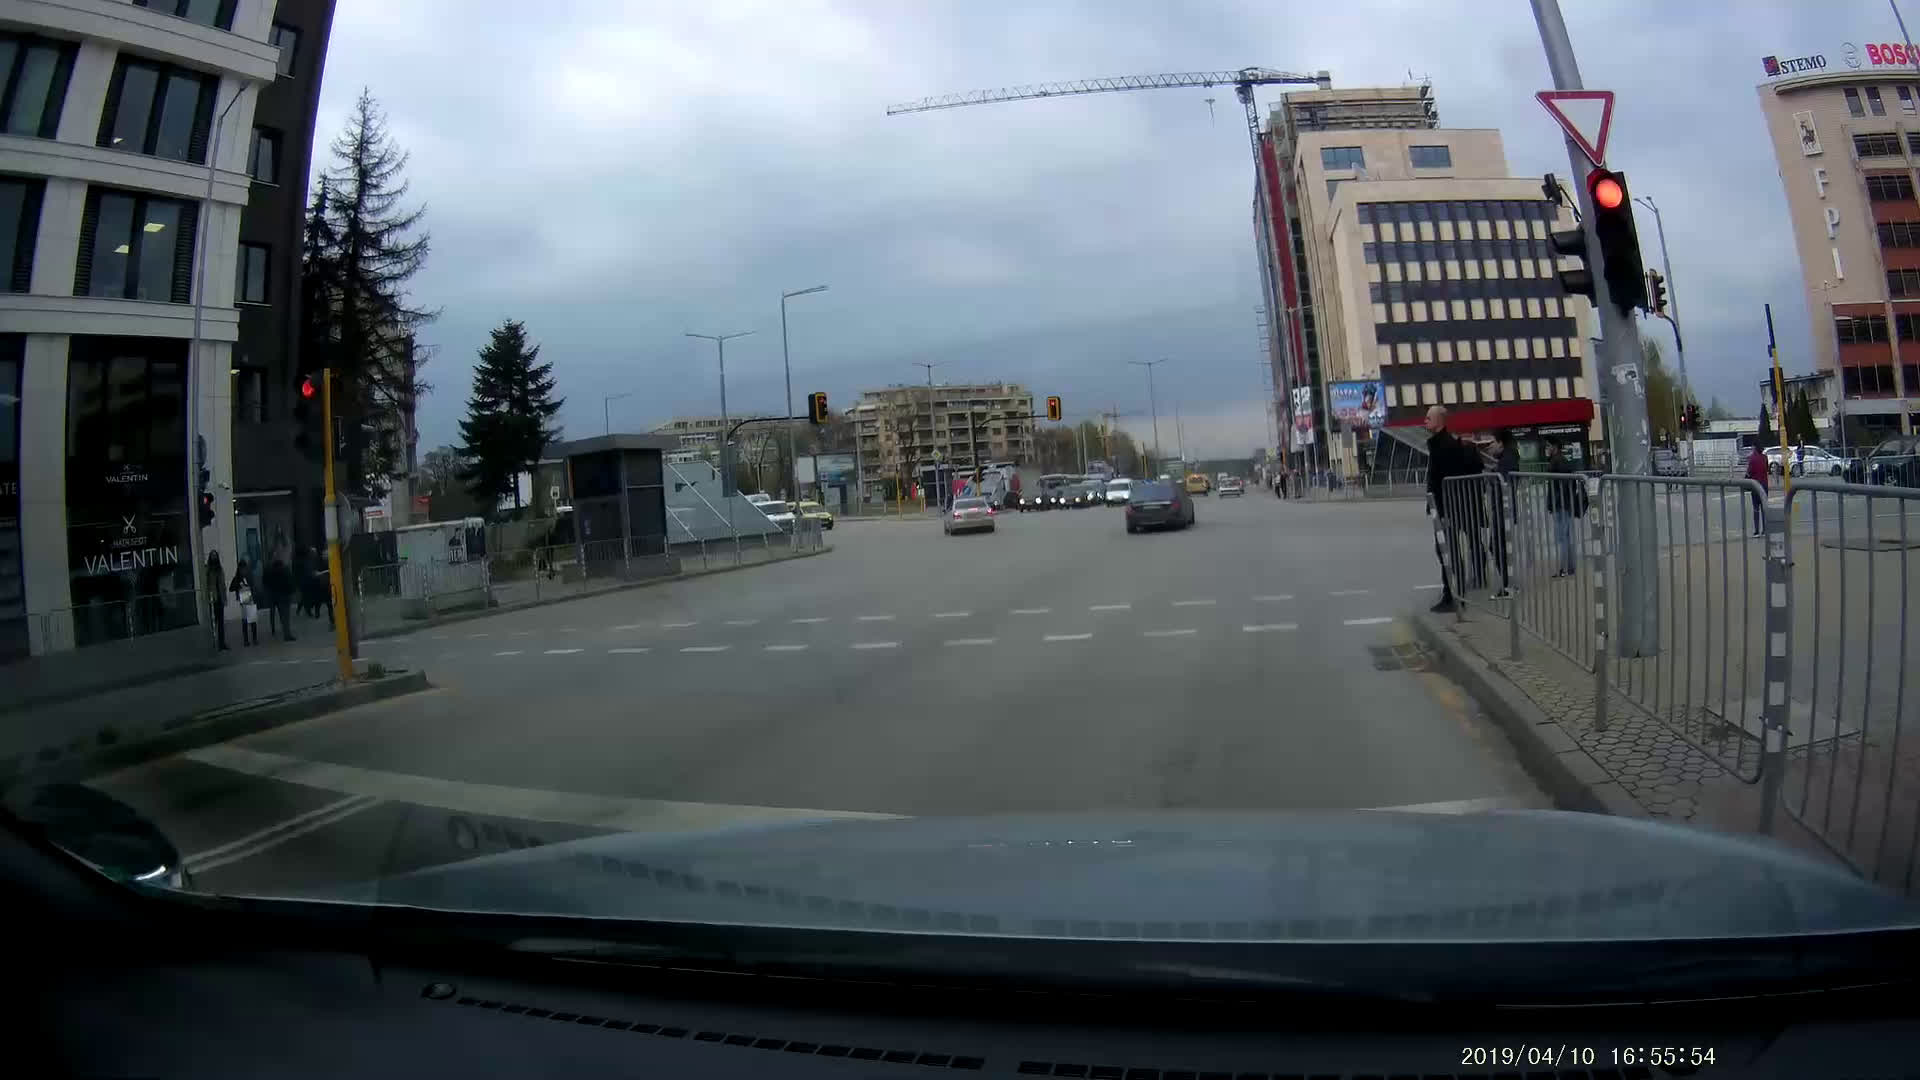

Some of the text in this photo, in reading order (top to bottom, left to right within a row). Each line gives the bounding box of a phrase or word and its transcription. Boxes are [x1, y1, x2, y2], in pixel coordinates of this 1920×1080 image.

[1780, 55, 1827, 74] STEMO
[105, 473, 148, 482] VALENTIN
[84, 545, 179, 576] VALENTIN
